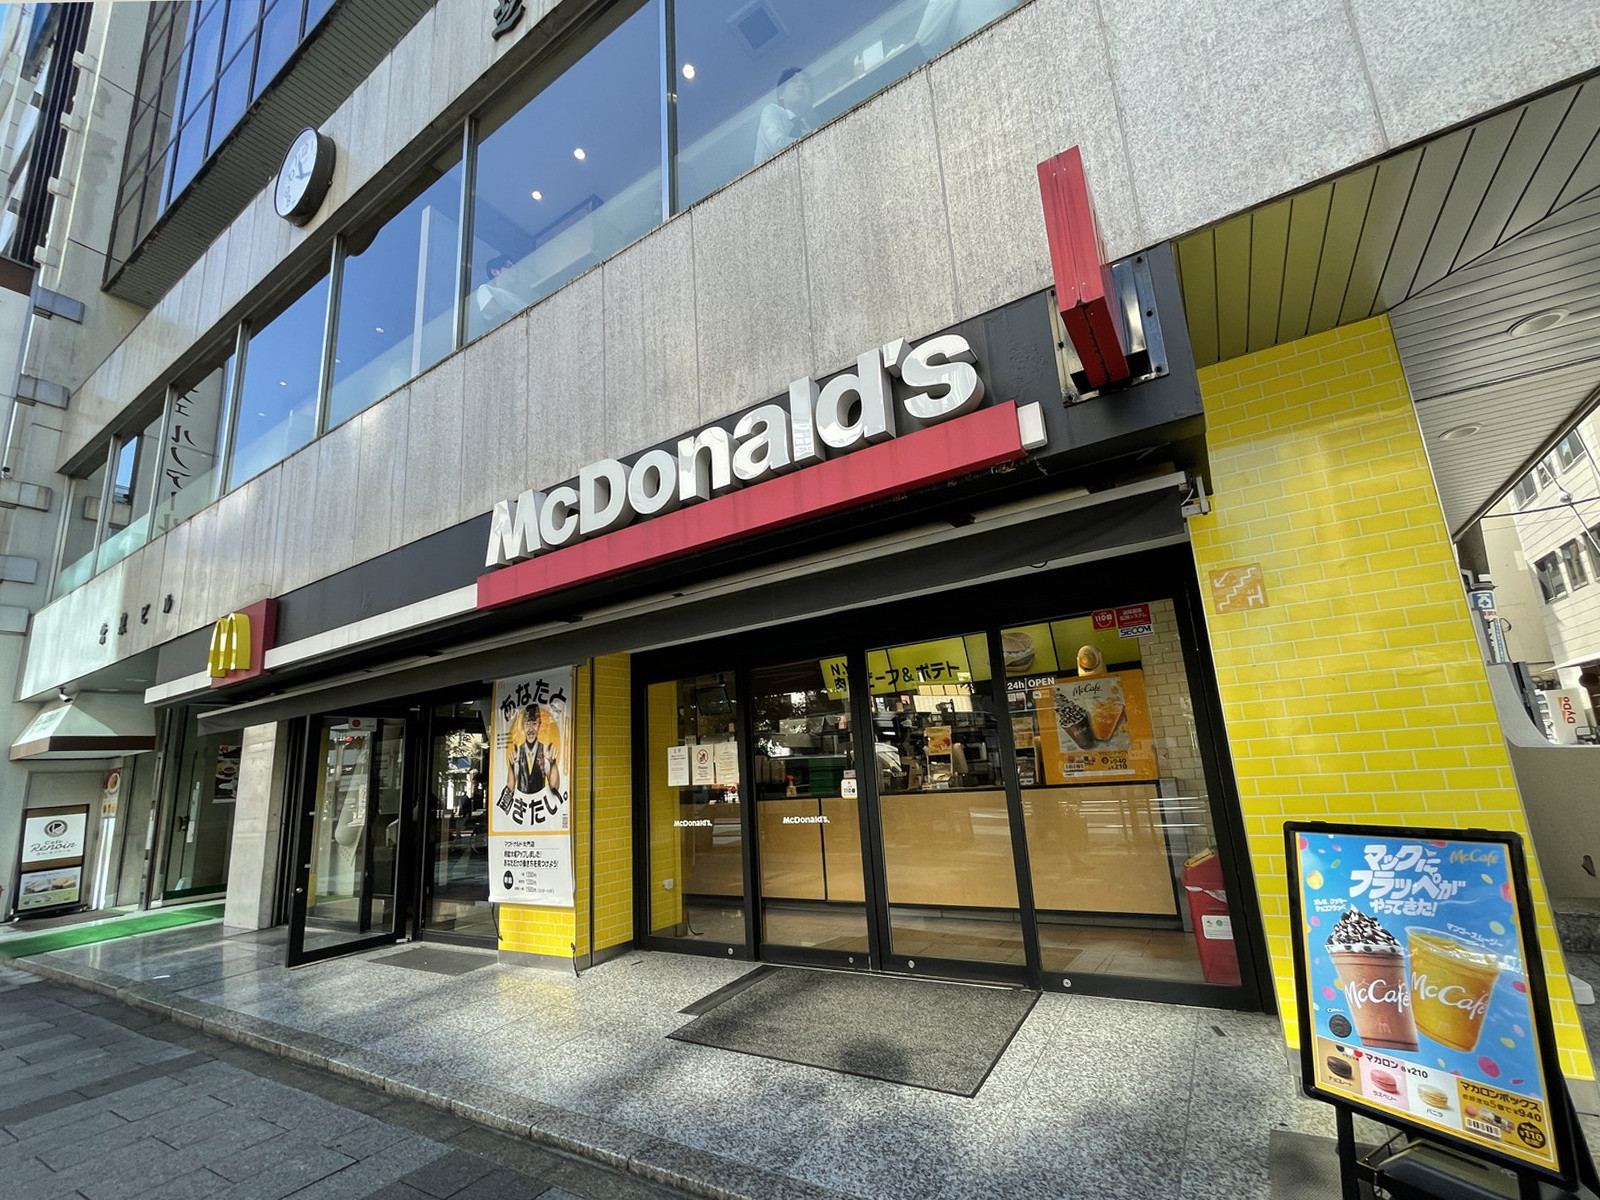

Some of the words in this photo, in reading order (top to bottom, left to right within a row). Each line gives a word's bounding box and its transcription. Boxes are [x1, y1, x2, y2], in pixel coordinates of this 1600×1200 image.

[485, 334, 984, 567] McDonald's
[1120, 625, 1152, 636] SECOM
[1007, 681, 1025, 690] 24h
[1028, 677, 1055, 688] OPEN
[1563, 696, 1576, 724] DyDo
[673, 819, 710, 828] McDonald's
[783, 815, 827, 825] McDonald's
[1364, 844, 1442, 874] マックに
[1449, 850, 1500, 867] McCafé
[1349, 869, 1467, 900] フラッペが
[1369, 898, 1439, 917] やってきた!
[1364, 1052, 1399, 1069] マカロン
[1460, 1081, 1541, 1112] マカロンボックス
